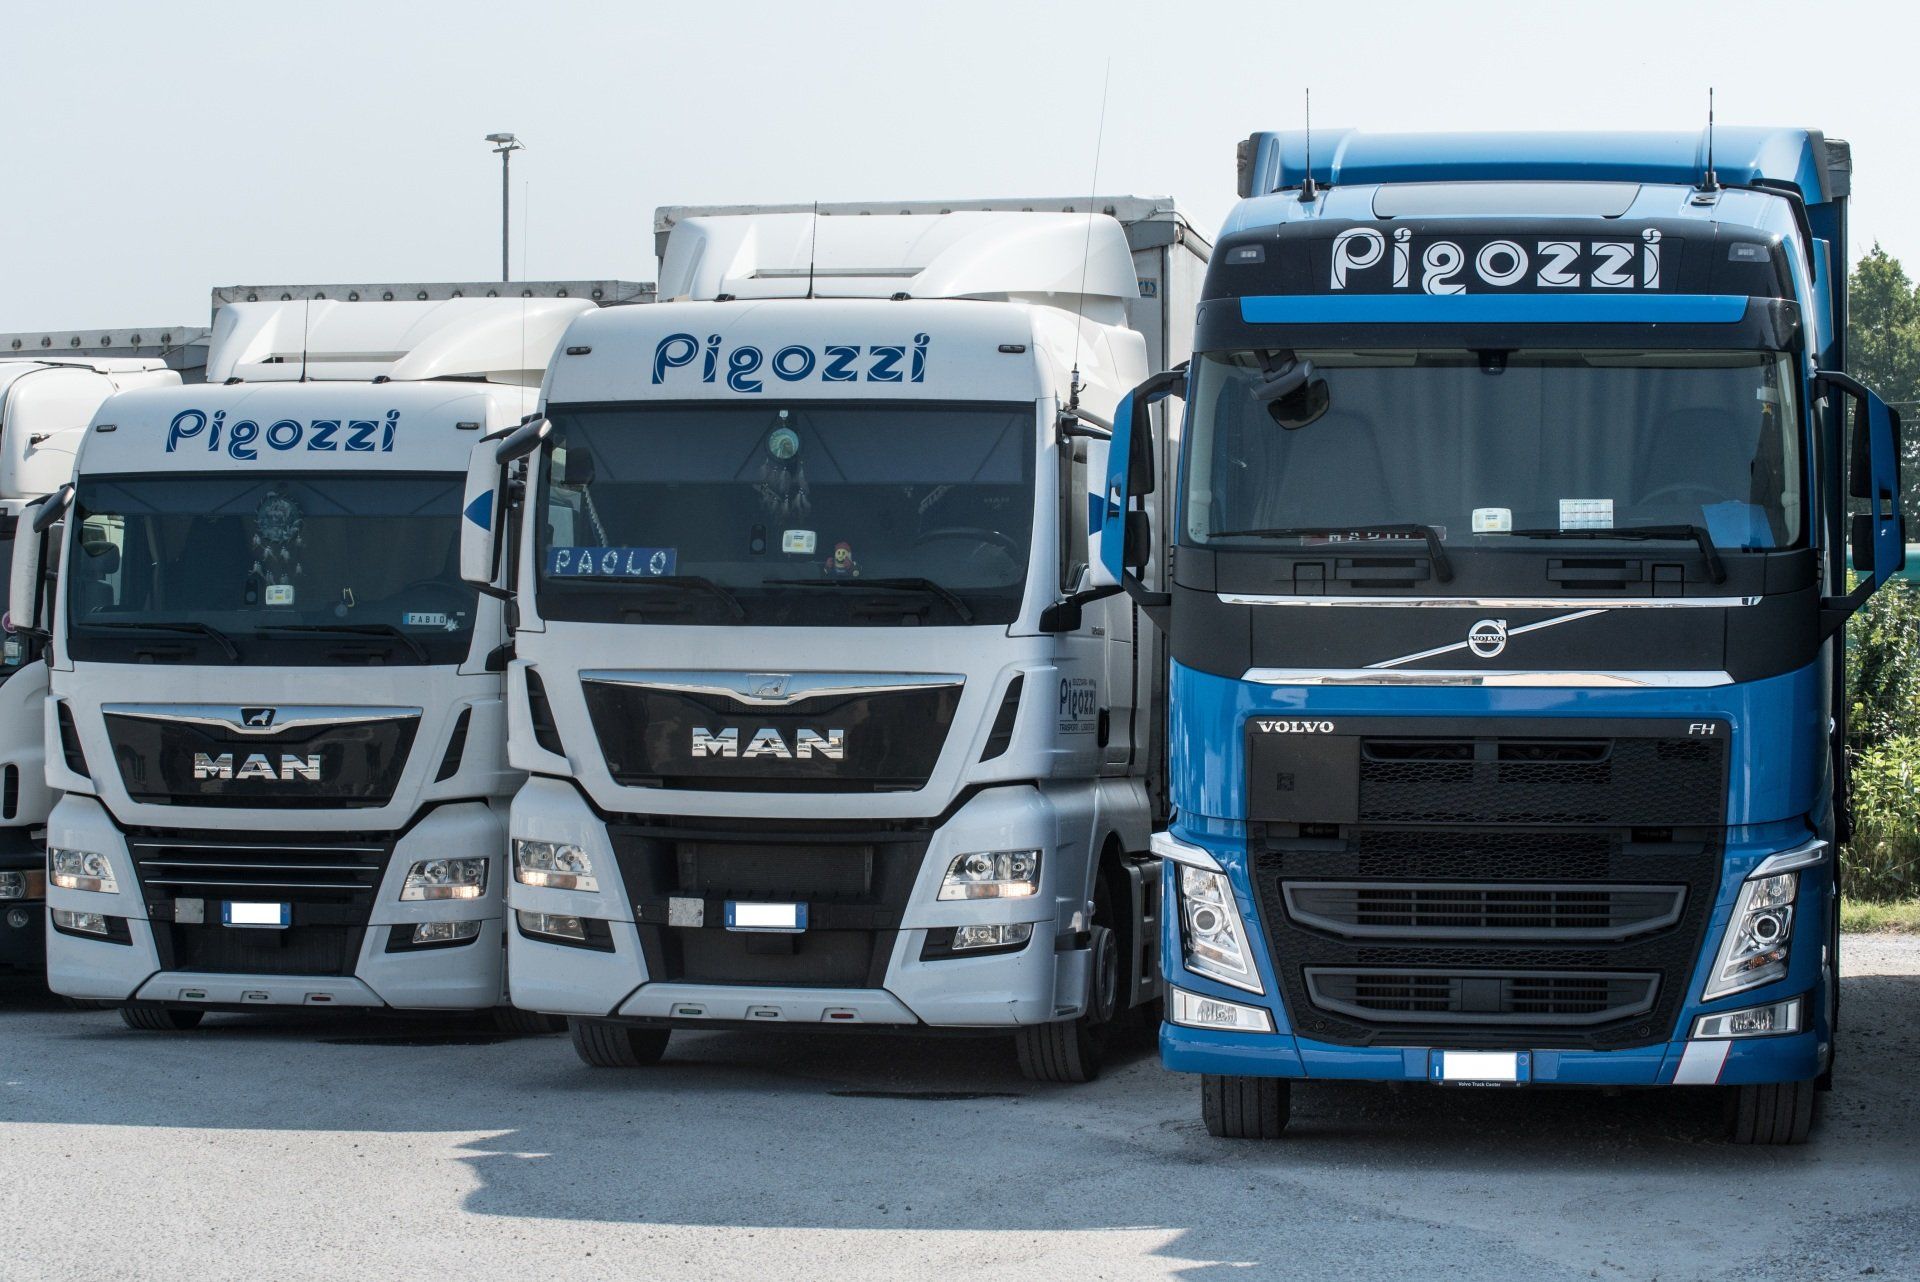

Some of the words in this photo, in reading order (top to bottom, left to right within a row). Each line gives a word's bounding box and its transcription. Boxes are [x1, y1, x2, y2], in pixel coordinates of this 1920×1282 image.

[1330, 227, 1662, 296] Pigozzi
[651, 332, 931, 393] Pigozzi
[165, 408, 401, 460] Pigozzi
[555, 549, 667, 575] PAOLO
[410, 615, 445, 623] FABIO
[1059, 677, 1097, 721] Pigozzi
[1256, 720, 1335, 733] VOLVO
[1688, 723, 1716, 735] FH
[691, 727, 845, 759] MAN
[194, 752, 321, 780] MAN
